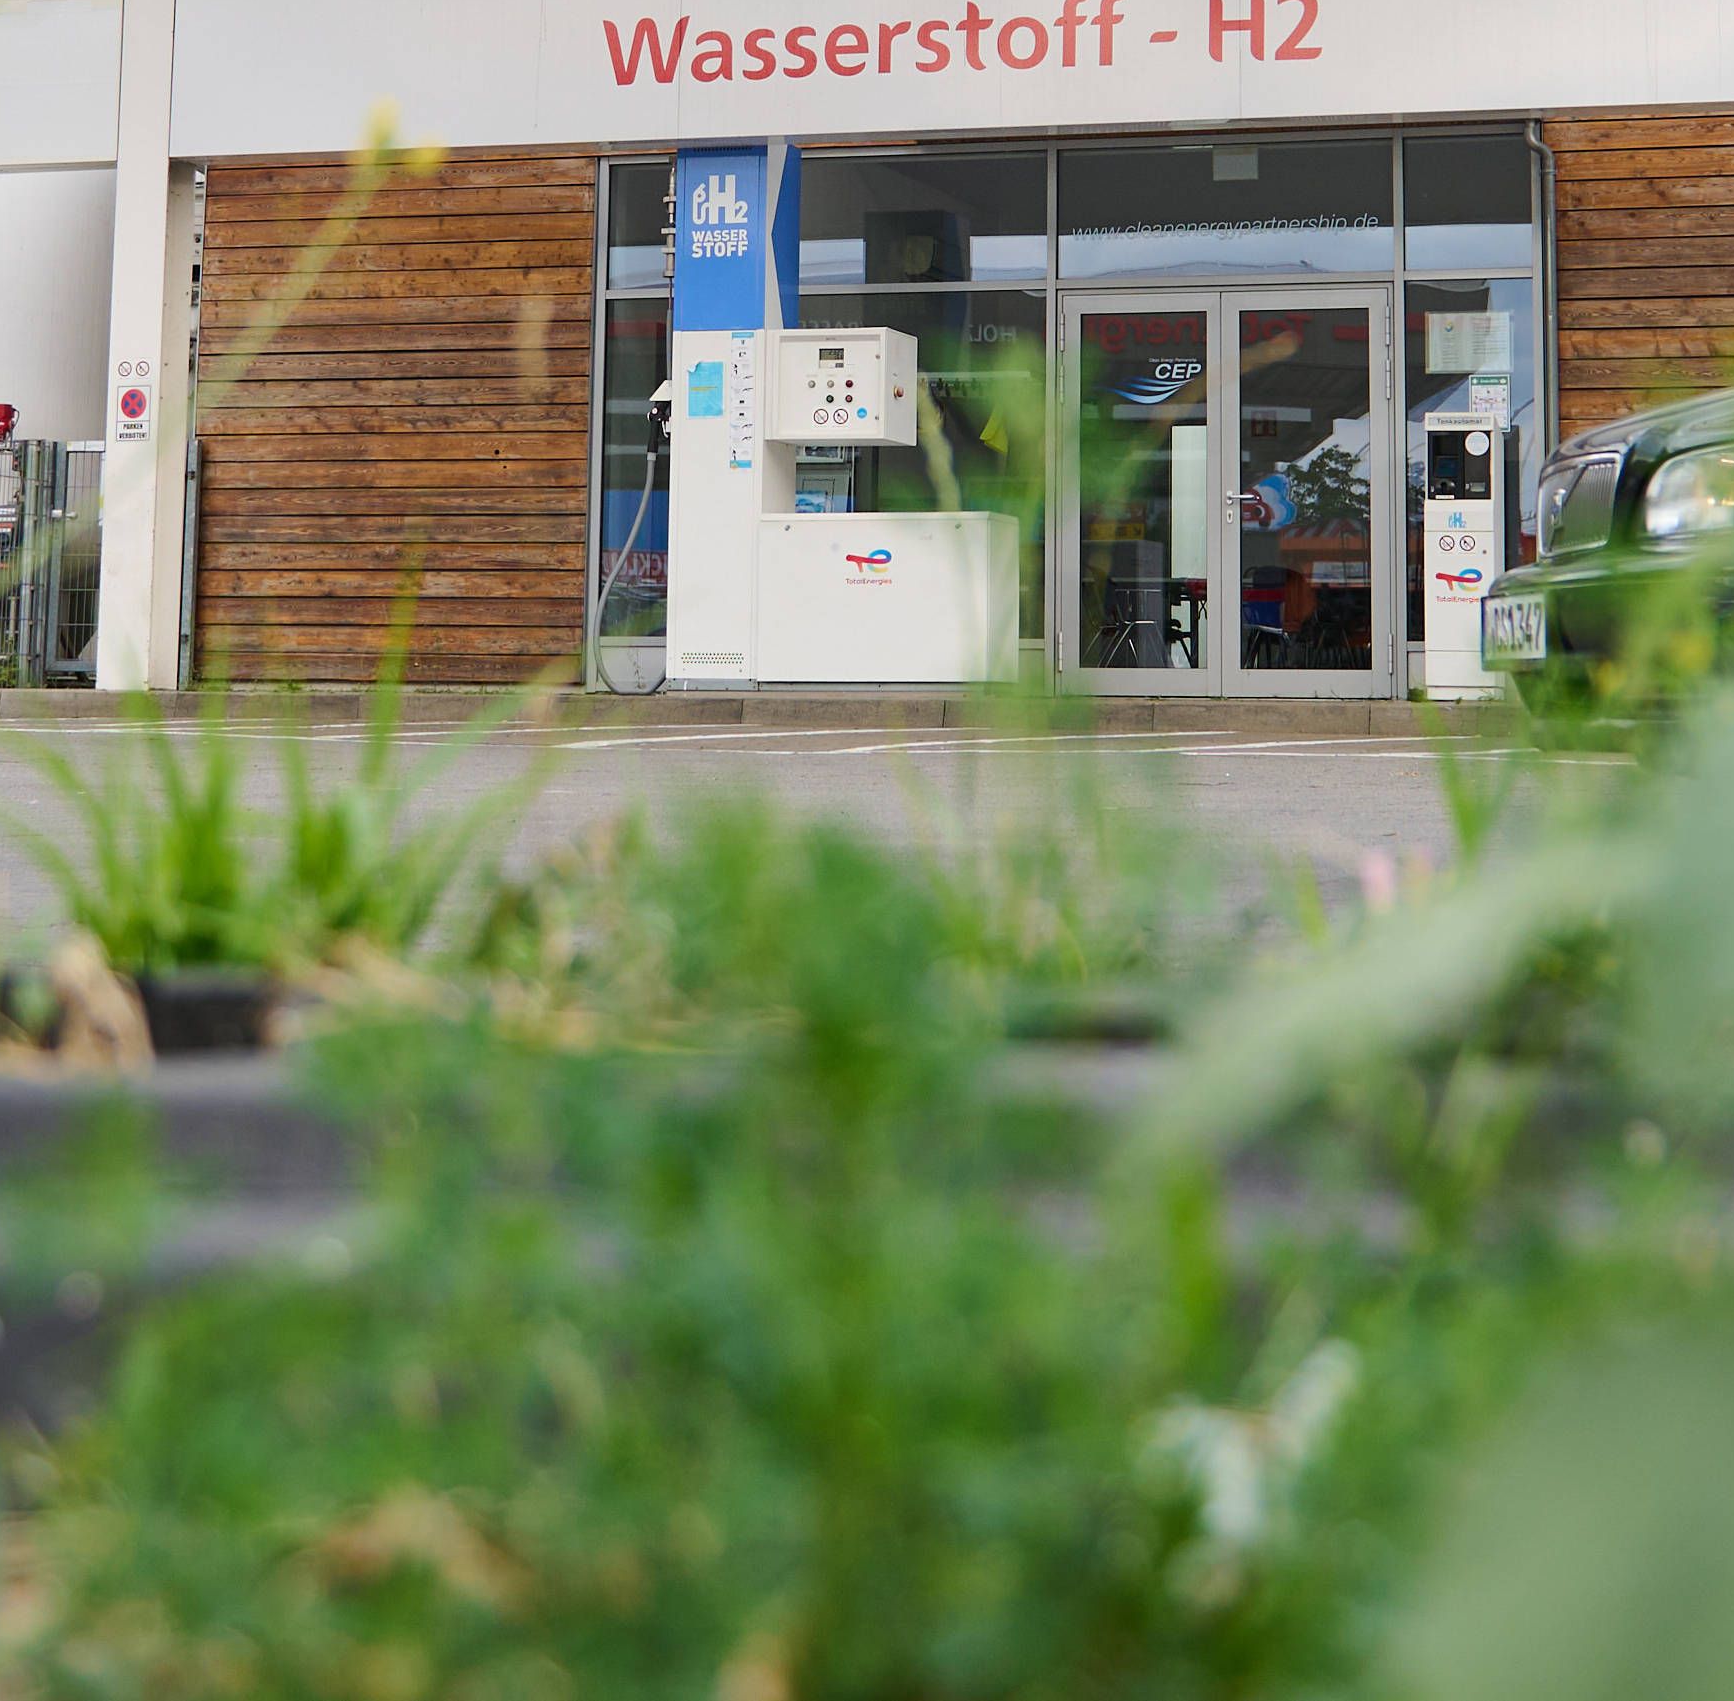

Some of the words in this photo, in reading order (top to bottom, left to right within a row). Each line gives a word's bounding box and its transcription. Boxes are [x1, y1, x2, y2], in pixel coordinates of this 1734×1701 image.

[1072, 213, 1379, 240] www.cleanenergypartnership.de
[692, 229, 747, 242] WASSER
[692, 241, 748, 258] STOFF
[1155, 363, 1202, 379] CEP
[846, 578, 892, 586] TotalEnergies
